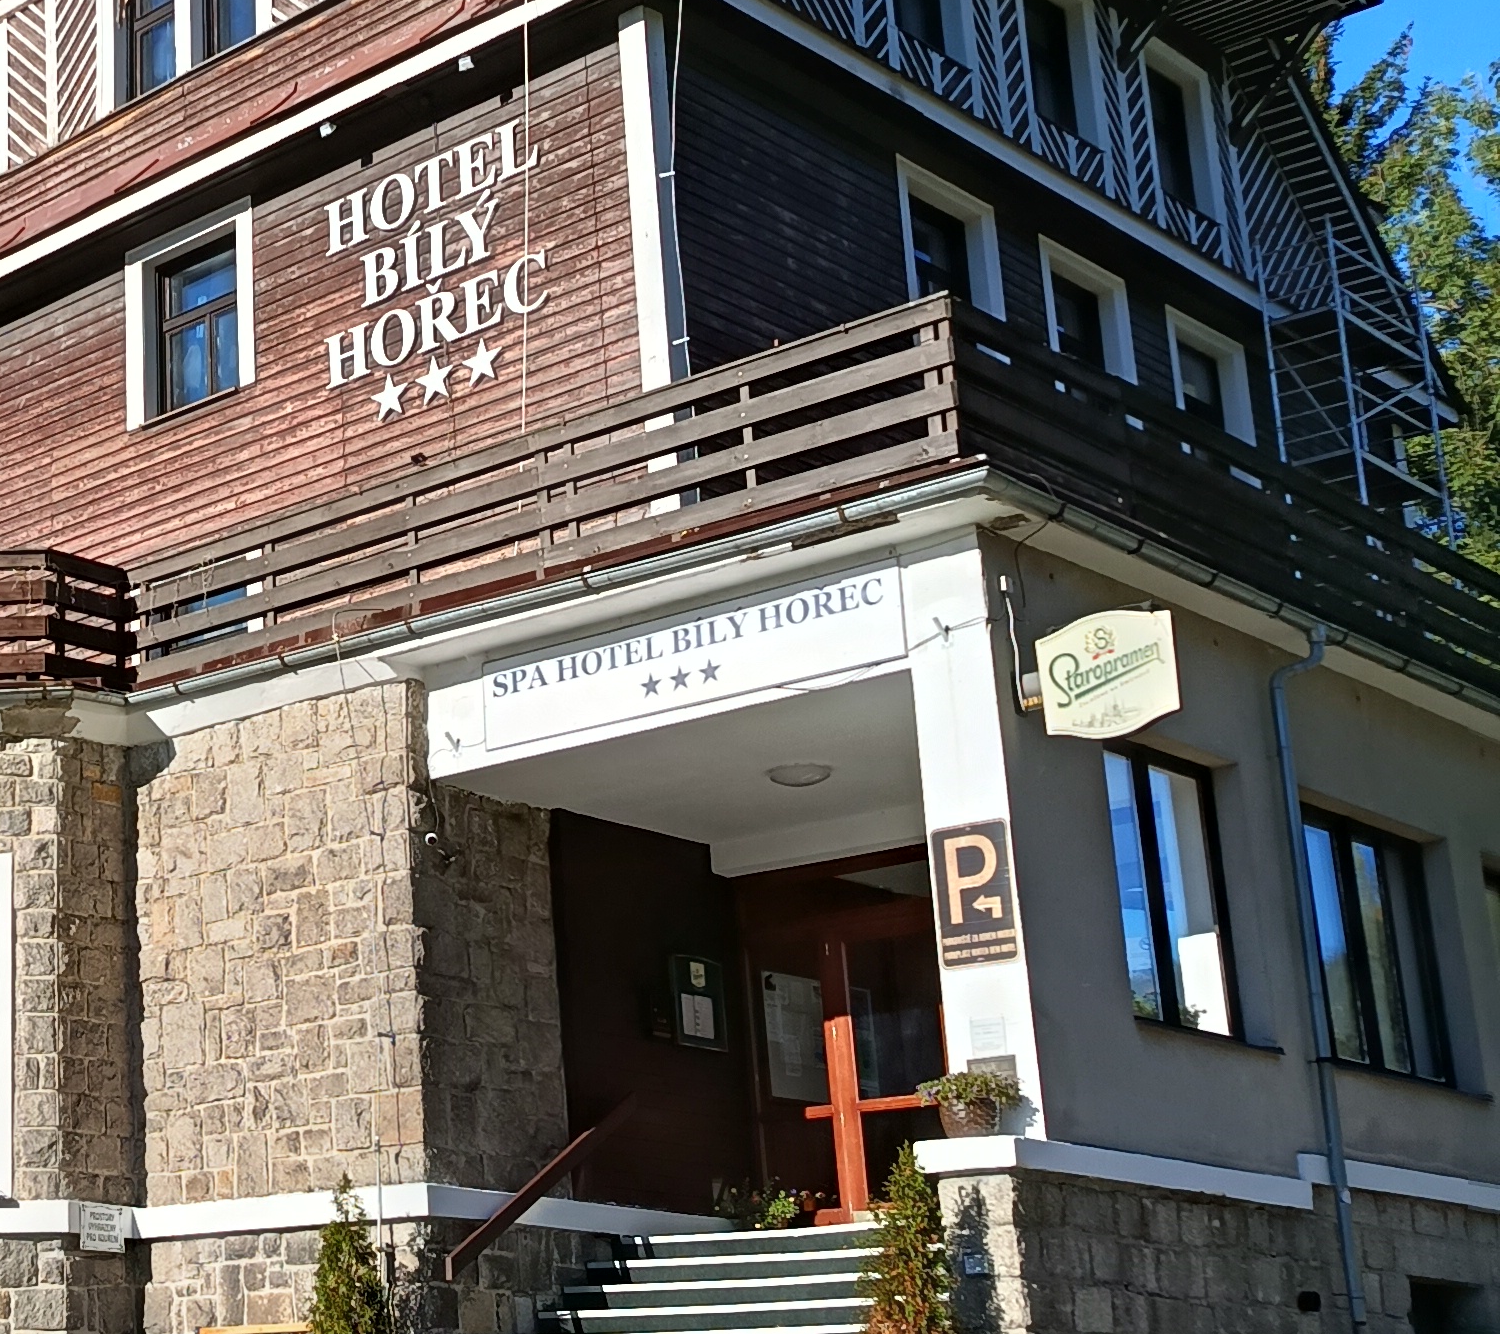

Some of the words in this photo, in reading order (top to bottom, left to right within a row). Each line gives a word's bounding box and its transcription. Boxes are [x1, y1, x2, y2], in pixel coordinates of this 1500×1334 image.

[324, 119, 540, 257] HOTEL
[360, 189, 499, 308] BÍLÝ
[324, 249, 550, 389] HOŘEC
[492, 669, 549, 698] SPA
[555, 636, 664, 683] HOTEL
[670, 605, 750, 654] BÍLÝ
[757, 578, 886, 633] HOŘEC
[1049, 641, 1166, 709] Staropramen
[943, 834, 998, 925] P
